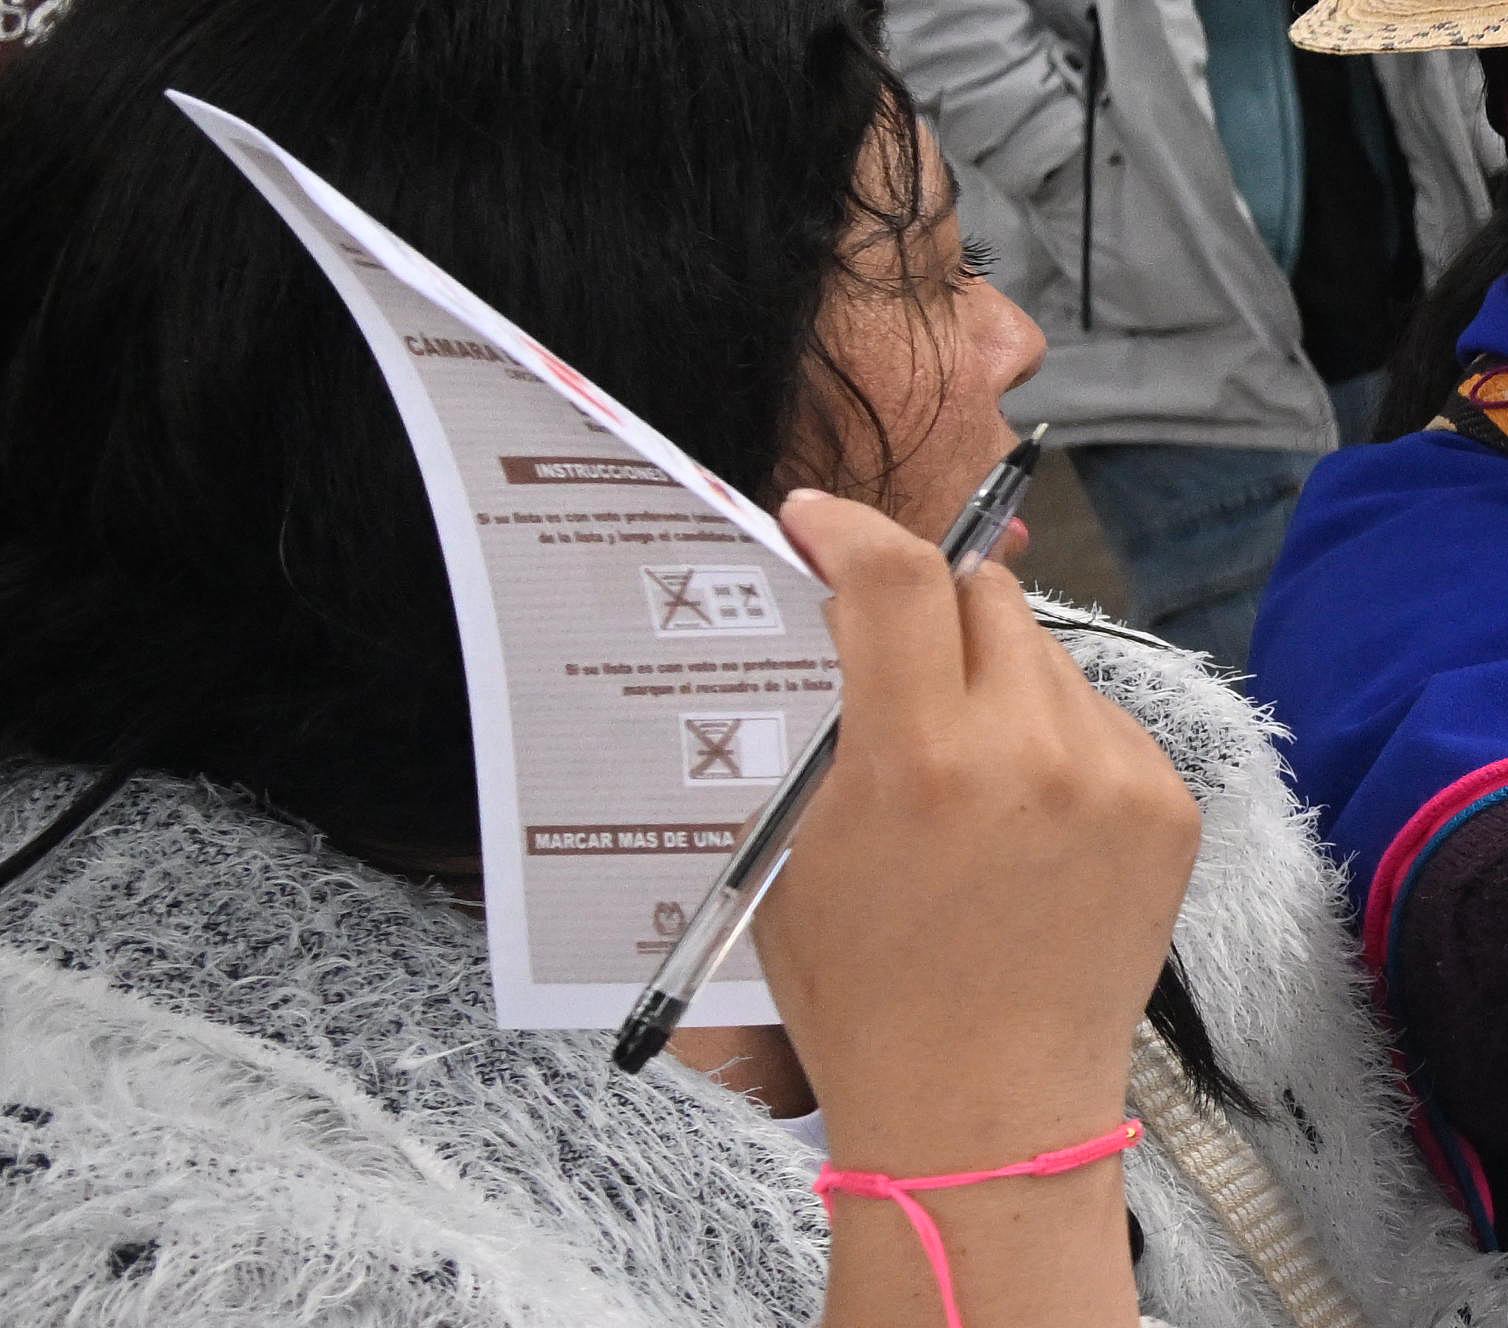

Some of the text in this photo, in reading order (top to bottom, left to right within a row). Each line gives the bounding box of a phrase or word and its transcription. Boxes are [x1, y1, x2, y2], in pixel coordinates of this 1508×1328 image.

[403, 333, 504, 363] CÁMARA
[534, 831, 614, 850] MARCAR
[663, 831, 690, 848] DE
[694, 830, 736, 847] UNA
